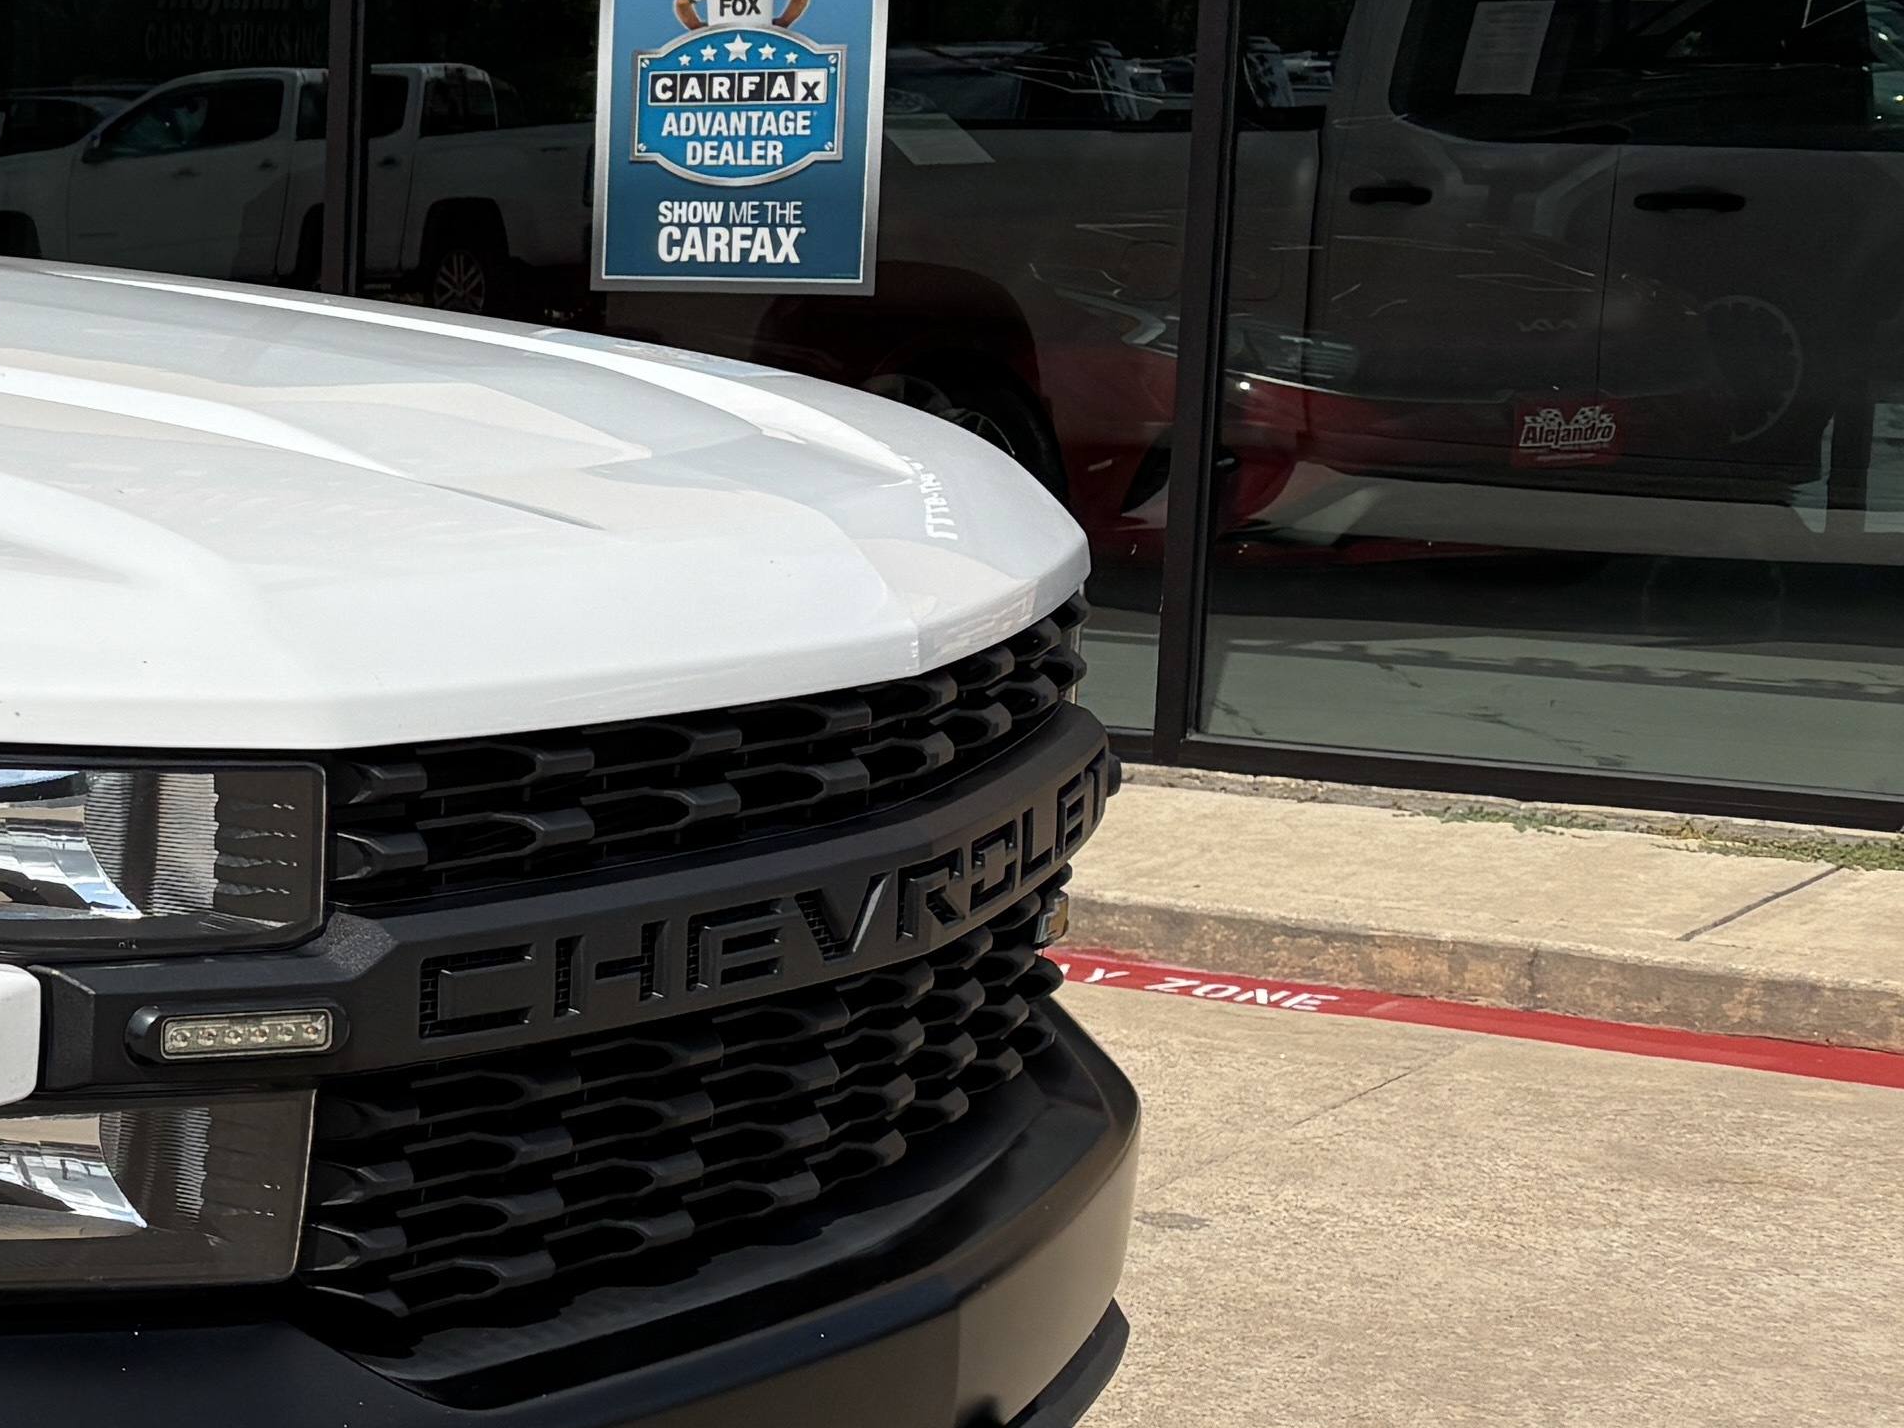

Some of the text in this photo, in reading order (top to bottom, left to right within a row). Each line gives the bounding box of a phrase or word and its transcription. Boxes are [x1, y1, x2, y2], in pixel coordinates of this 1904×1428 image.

[652, 74, 823, 103] CARFAX
[661, 111, 812, 137] ADVANTAGE
[686, 140, 784, 166] DEALER
[658, 200, 803, 225] SHOW ME THE
[657, 225, 801, 265] CARFAX
[1521, 419, 1614, 448] Alejandro
[1144, 975, 1342, 1012] ZONE
